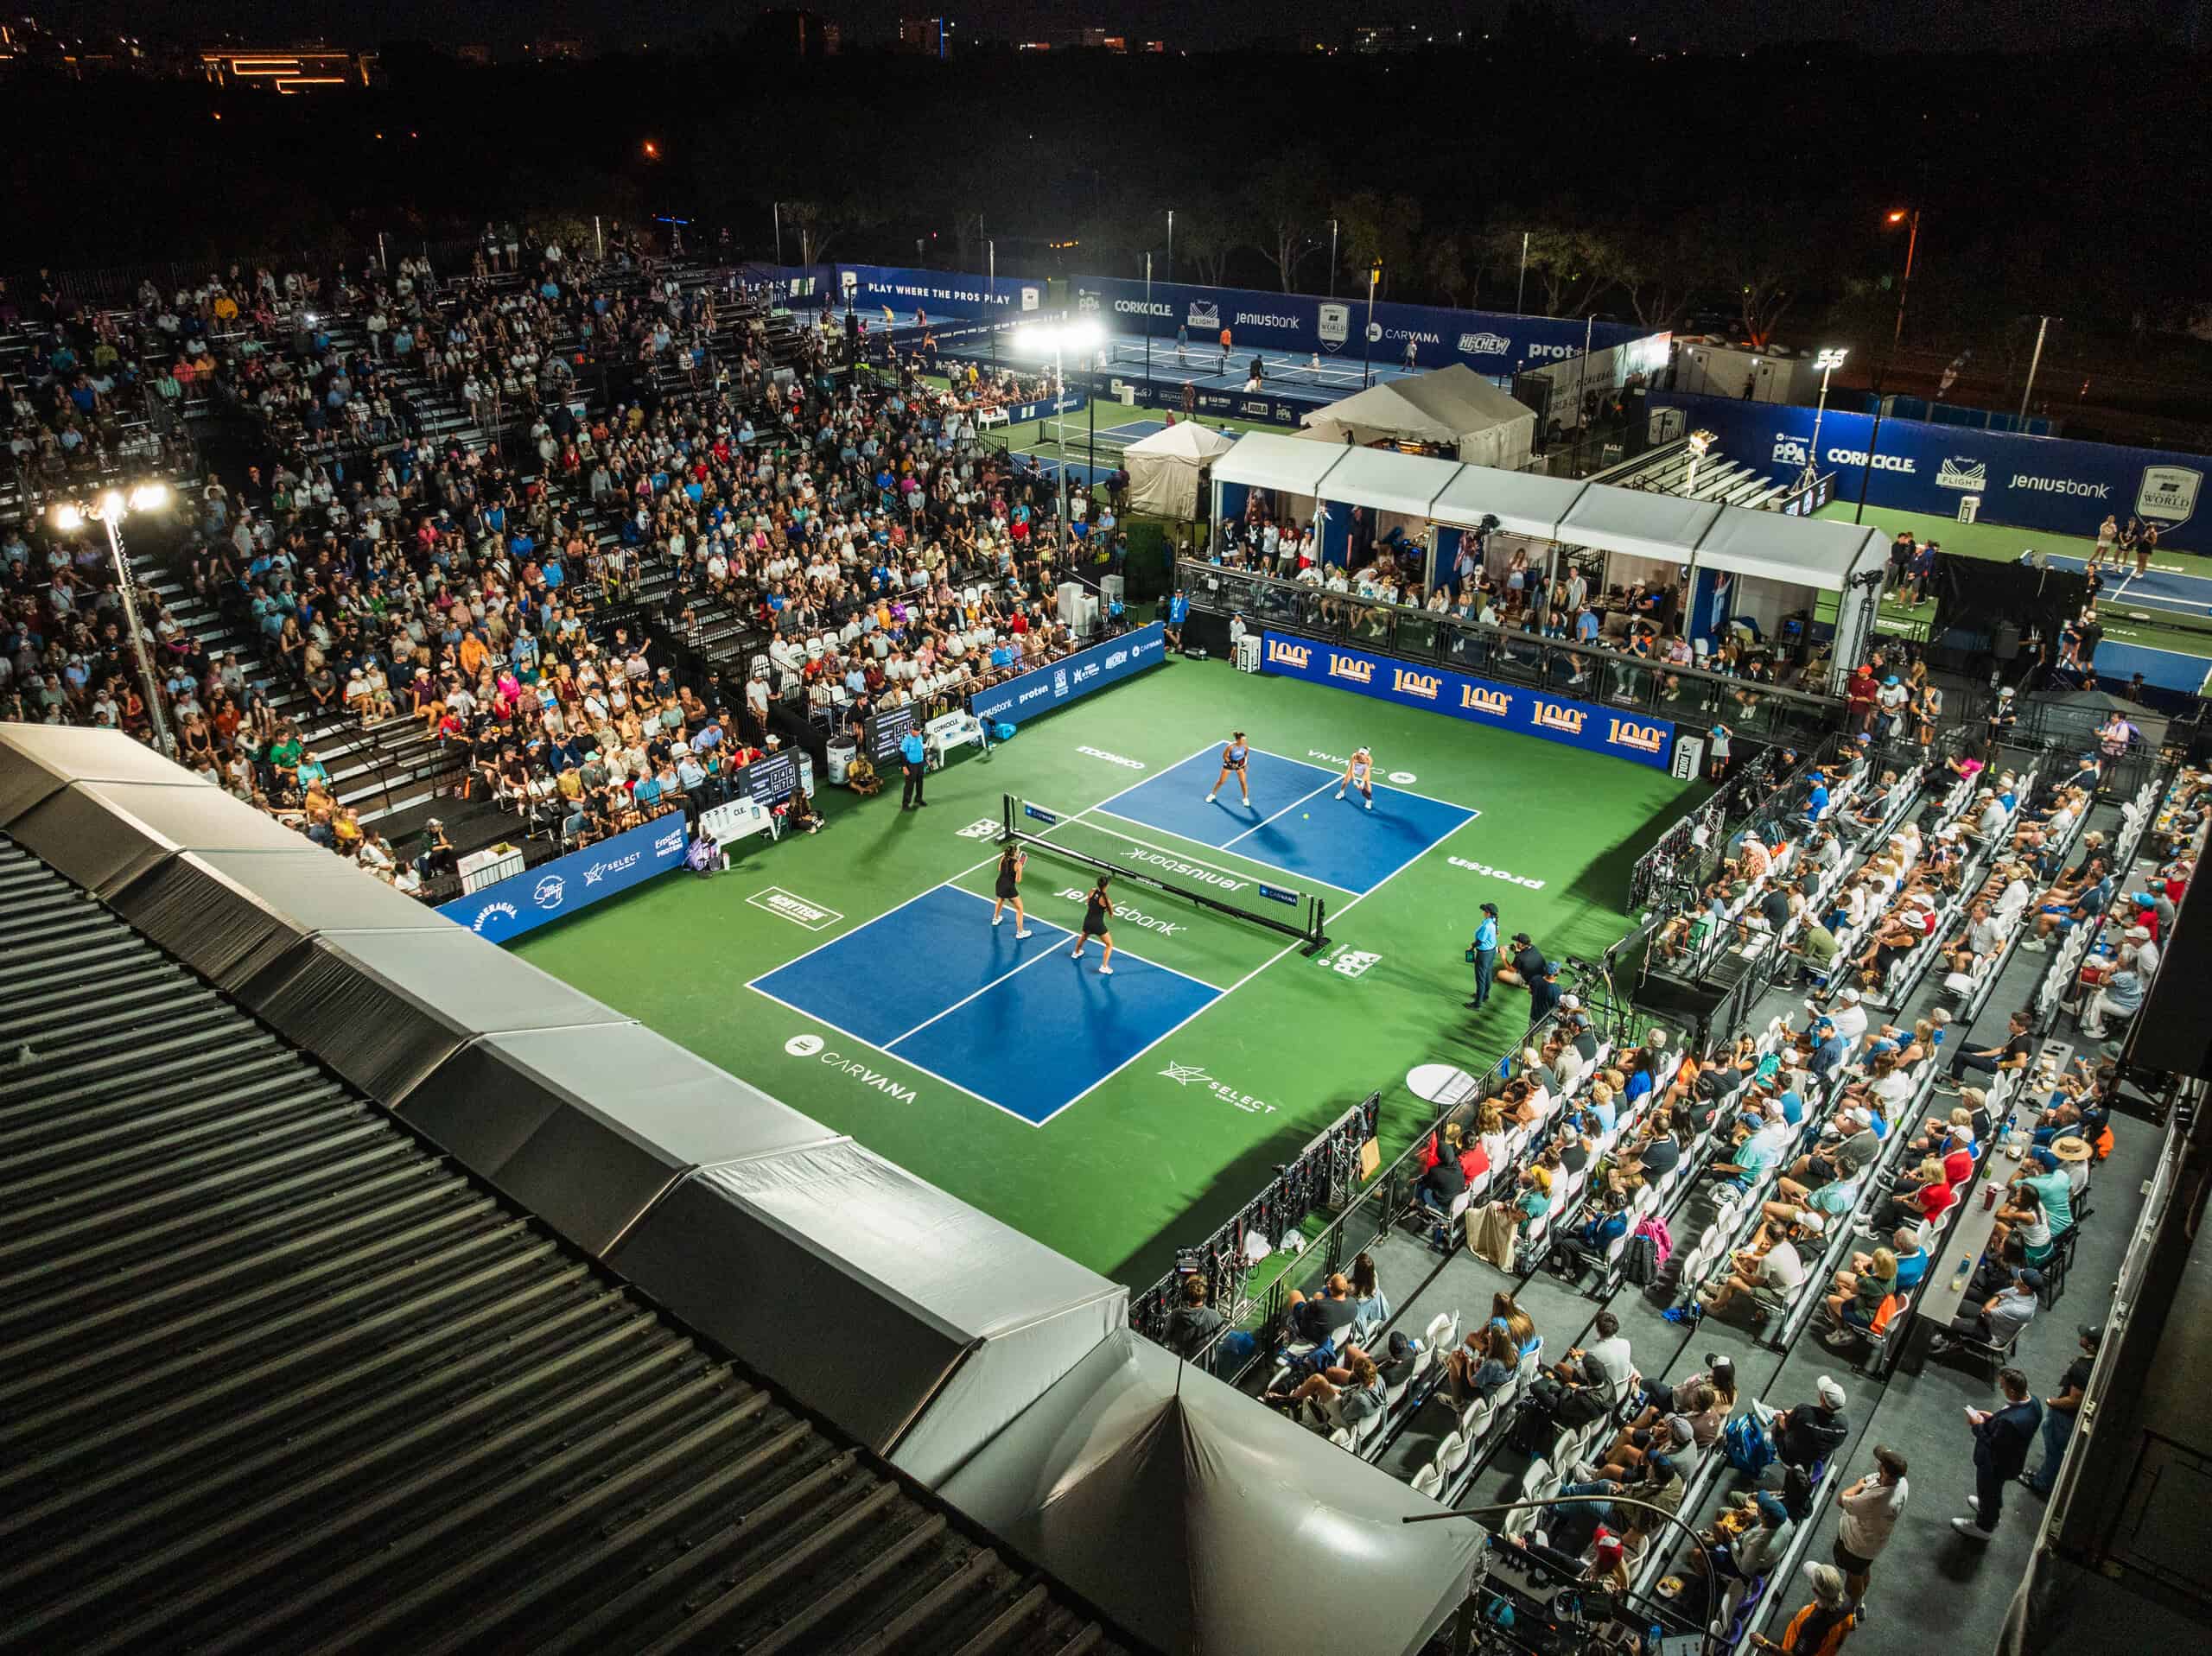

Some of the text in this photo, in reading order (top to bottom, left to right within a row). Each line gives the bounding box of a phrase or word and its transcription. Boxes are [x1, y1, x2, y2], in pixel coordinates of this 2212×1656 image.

[868, 282, 1009, 305] PLAY WHERE THE PROS PLAY
[1385, 329, 1440, 344] CARVANA
[1772, 442, 1807, 462] PPA
[1942, 476, 1978, 487] FLIGHT
[2144, 494, 2190, 507] WORLD
[607, 851, 641, 871] SELECT
[474, 902, 518, 932] MINERAGUA
[821, 1052, 918, 1106] CARVANA
[1208, 1082, 1276, 1114] SELECT
